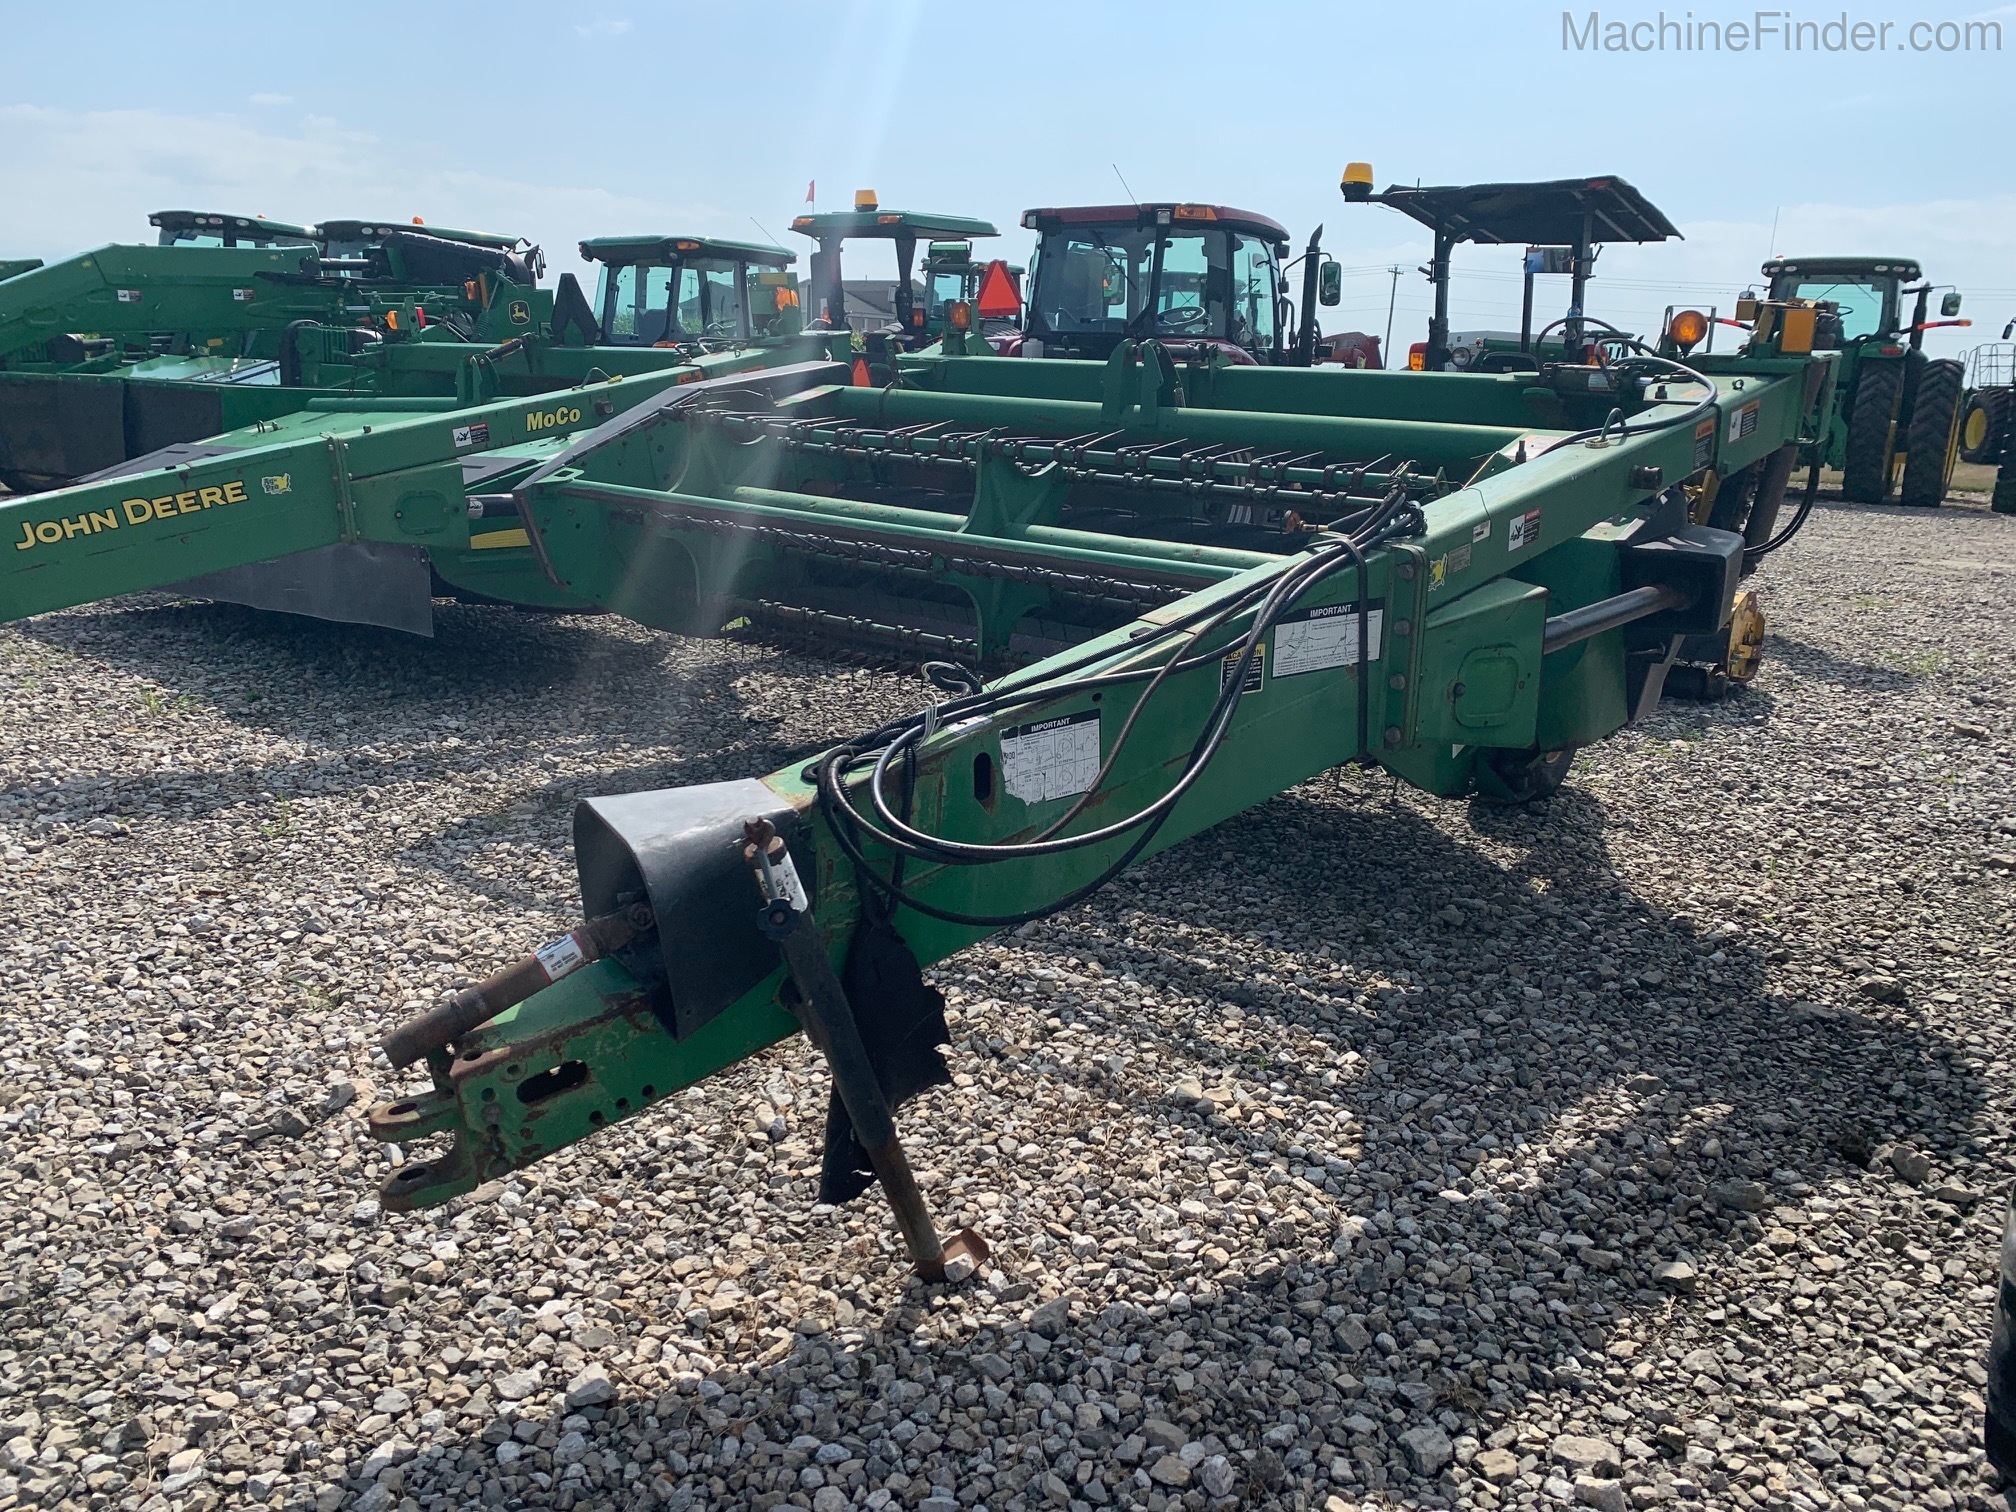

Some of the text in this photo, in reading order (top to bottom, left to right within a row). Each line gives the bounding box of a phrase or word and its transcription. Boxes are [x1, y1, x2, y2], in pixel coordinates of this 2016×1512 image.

[526, 406, 581, 432] MoCo
[15, 480, 248, 550] JOHN DEERE
[1310, 604, 1352, 618] IMPORTANT
[1031, 718, 1071, 732] IMPORTANT
